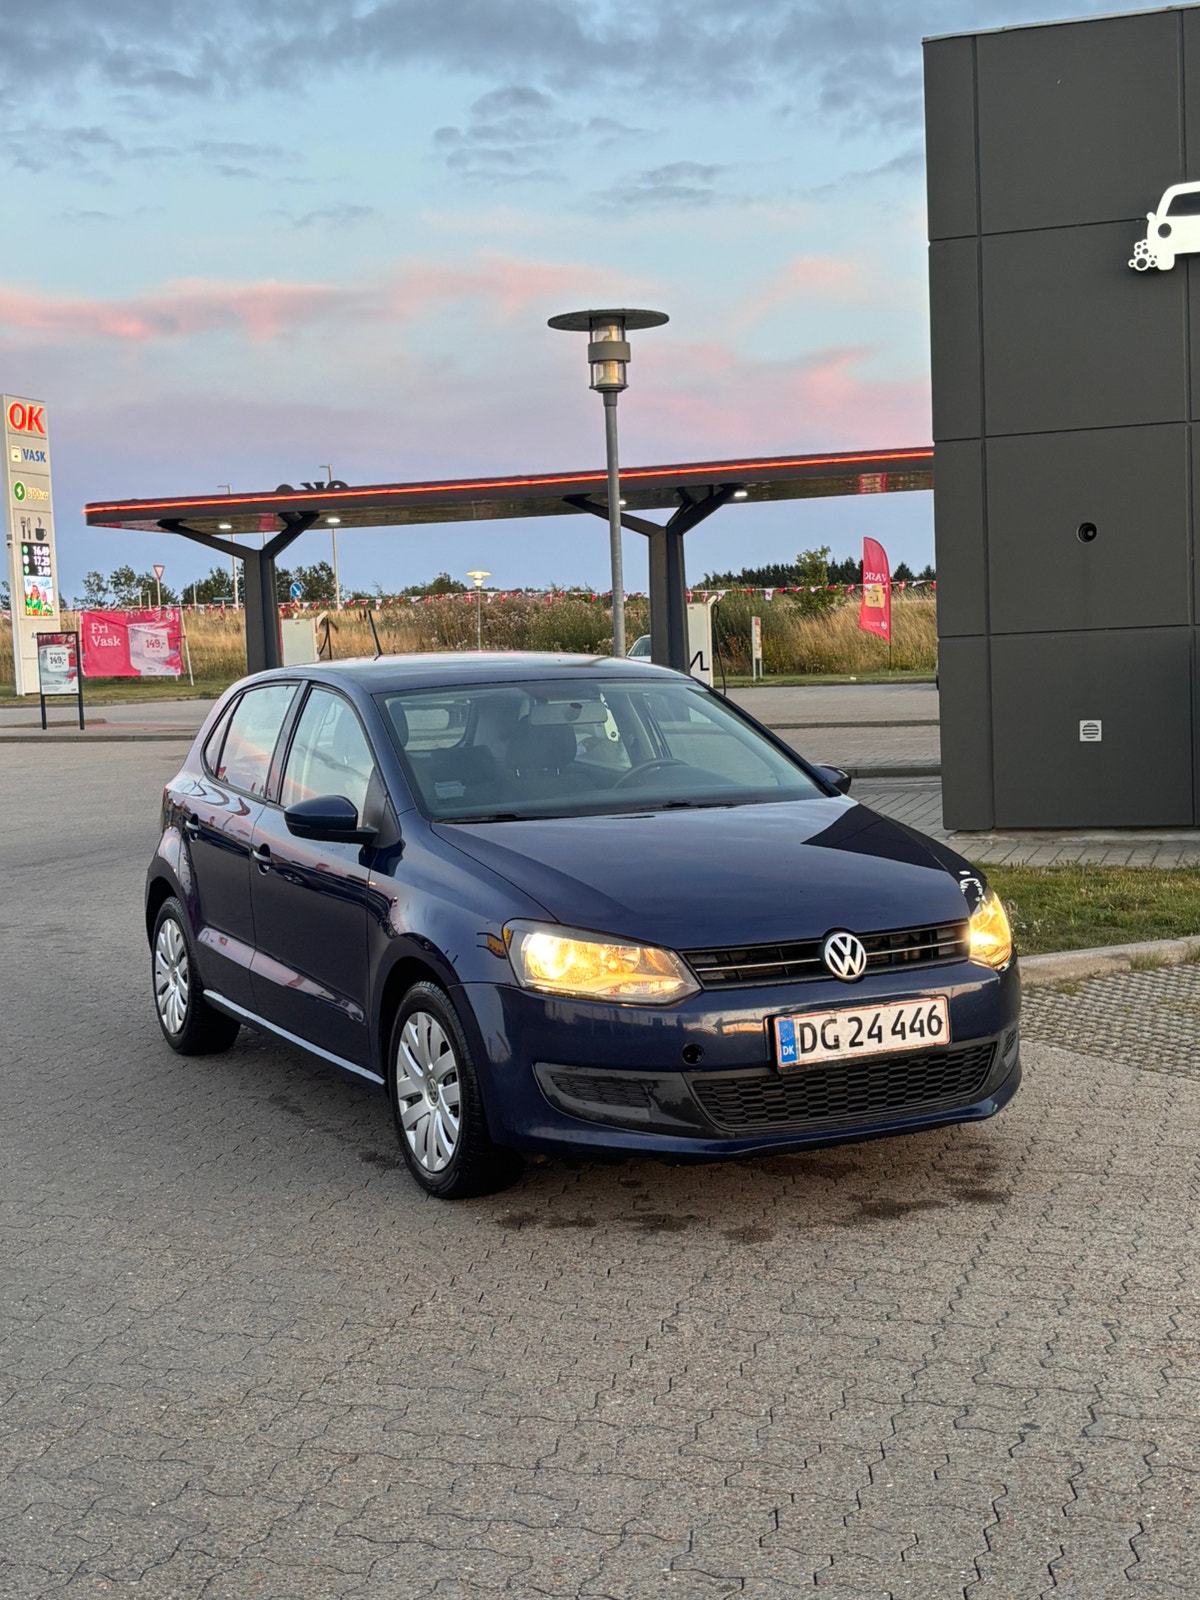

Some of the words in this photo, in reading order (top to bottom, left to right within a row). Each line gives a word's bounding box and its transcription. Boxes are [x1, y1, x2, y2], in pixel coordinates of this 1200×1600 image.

[8, 402, 45, 434] OK
[22, 448, 46, 462] VASK
[91, 623, 109, 634] Fri
[91, 636, 121, 647] Vask
[799, 1019, 840, 1054] DG
[848, 1013, 883, 1048] 24
[891, 1004, 943, 1040] 446
[783, 1045, 796, 1056] DK
